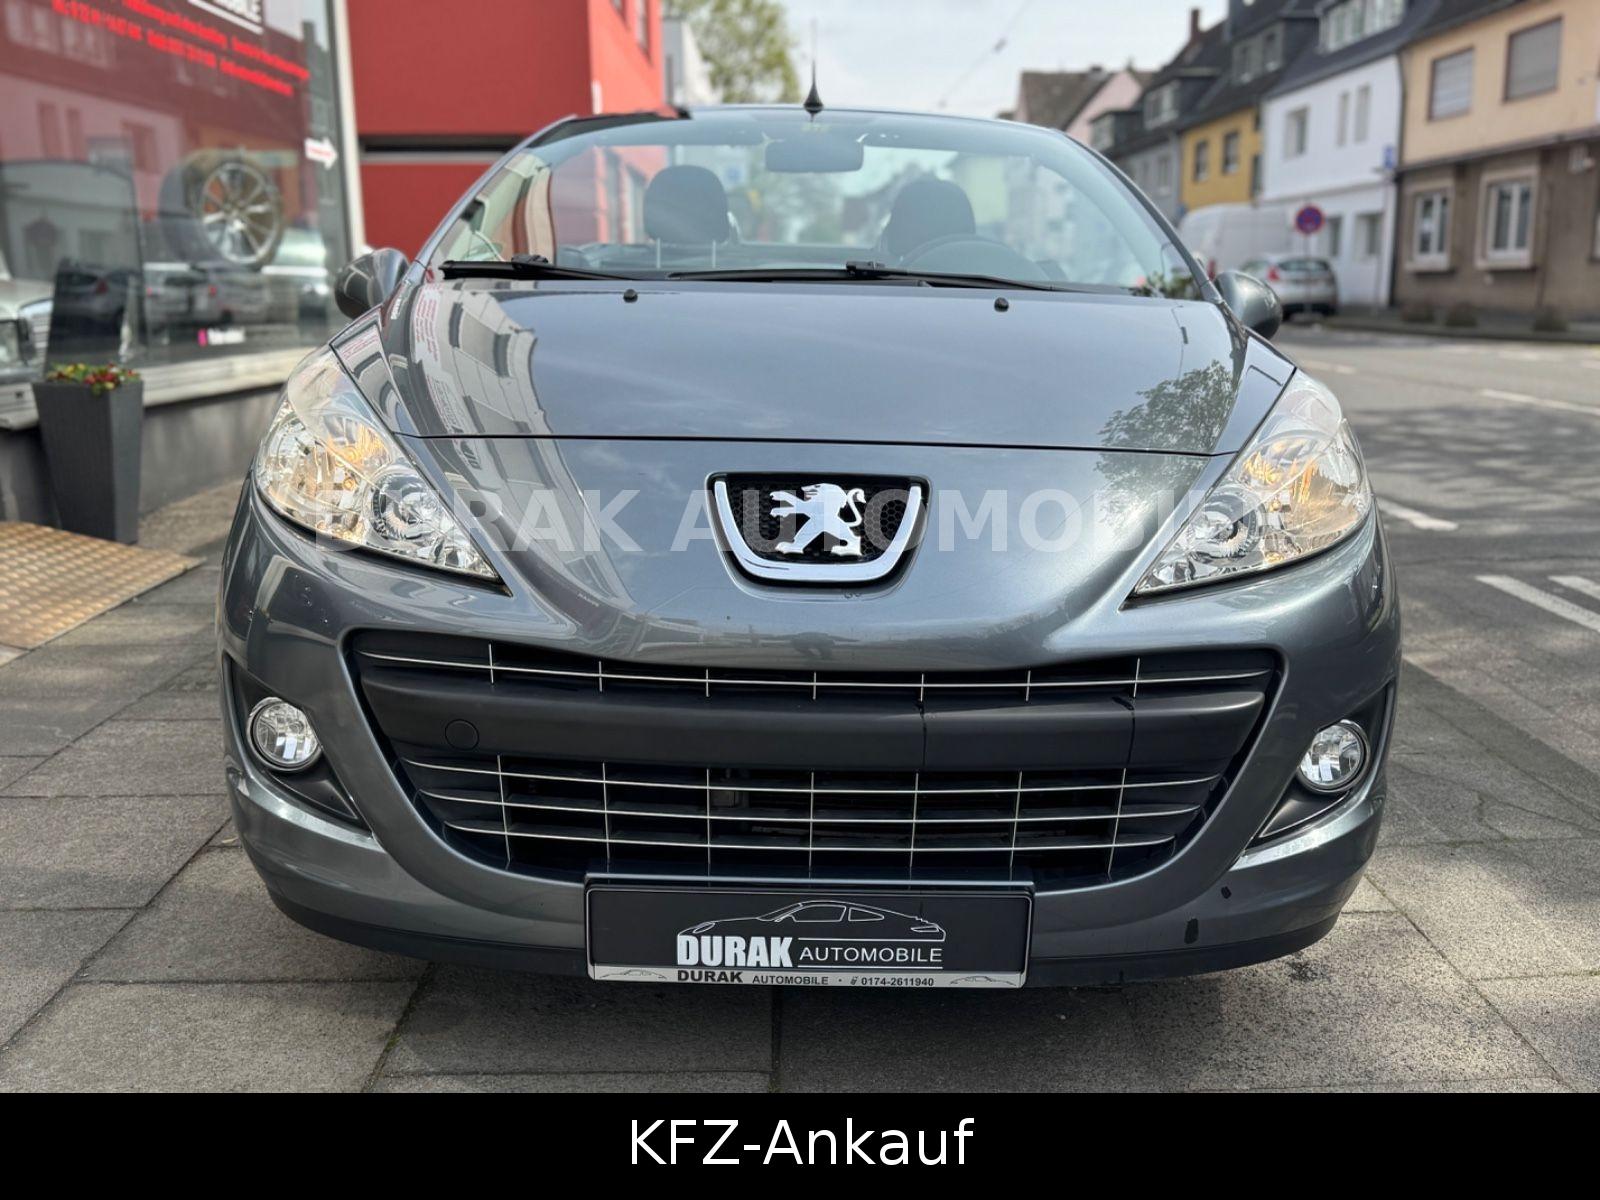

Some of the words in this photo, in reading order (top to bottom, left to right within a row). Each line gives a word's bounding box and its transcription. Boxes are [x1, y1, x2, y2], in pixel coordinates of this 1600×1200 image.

[676, 934, 793, 968] DURAK
[799, 947, 943, 962] AUTOMOBILE
[677, 969, 744, 983] DURAK
[752, 974, 829, 986] AUTOMOBILE
[861, 976, 935, 987] 0174-2611940
